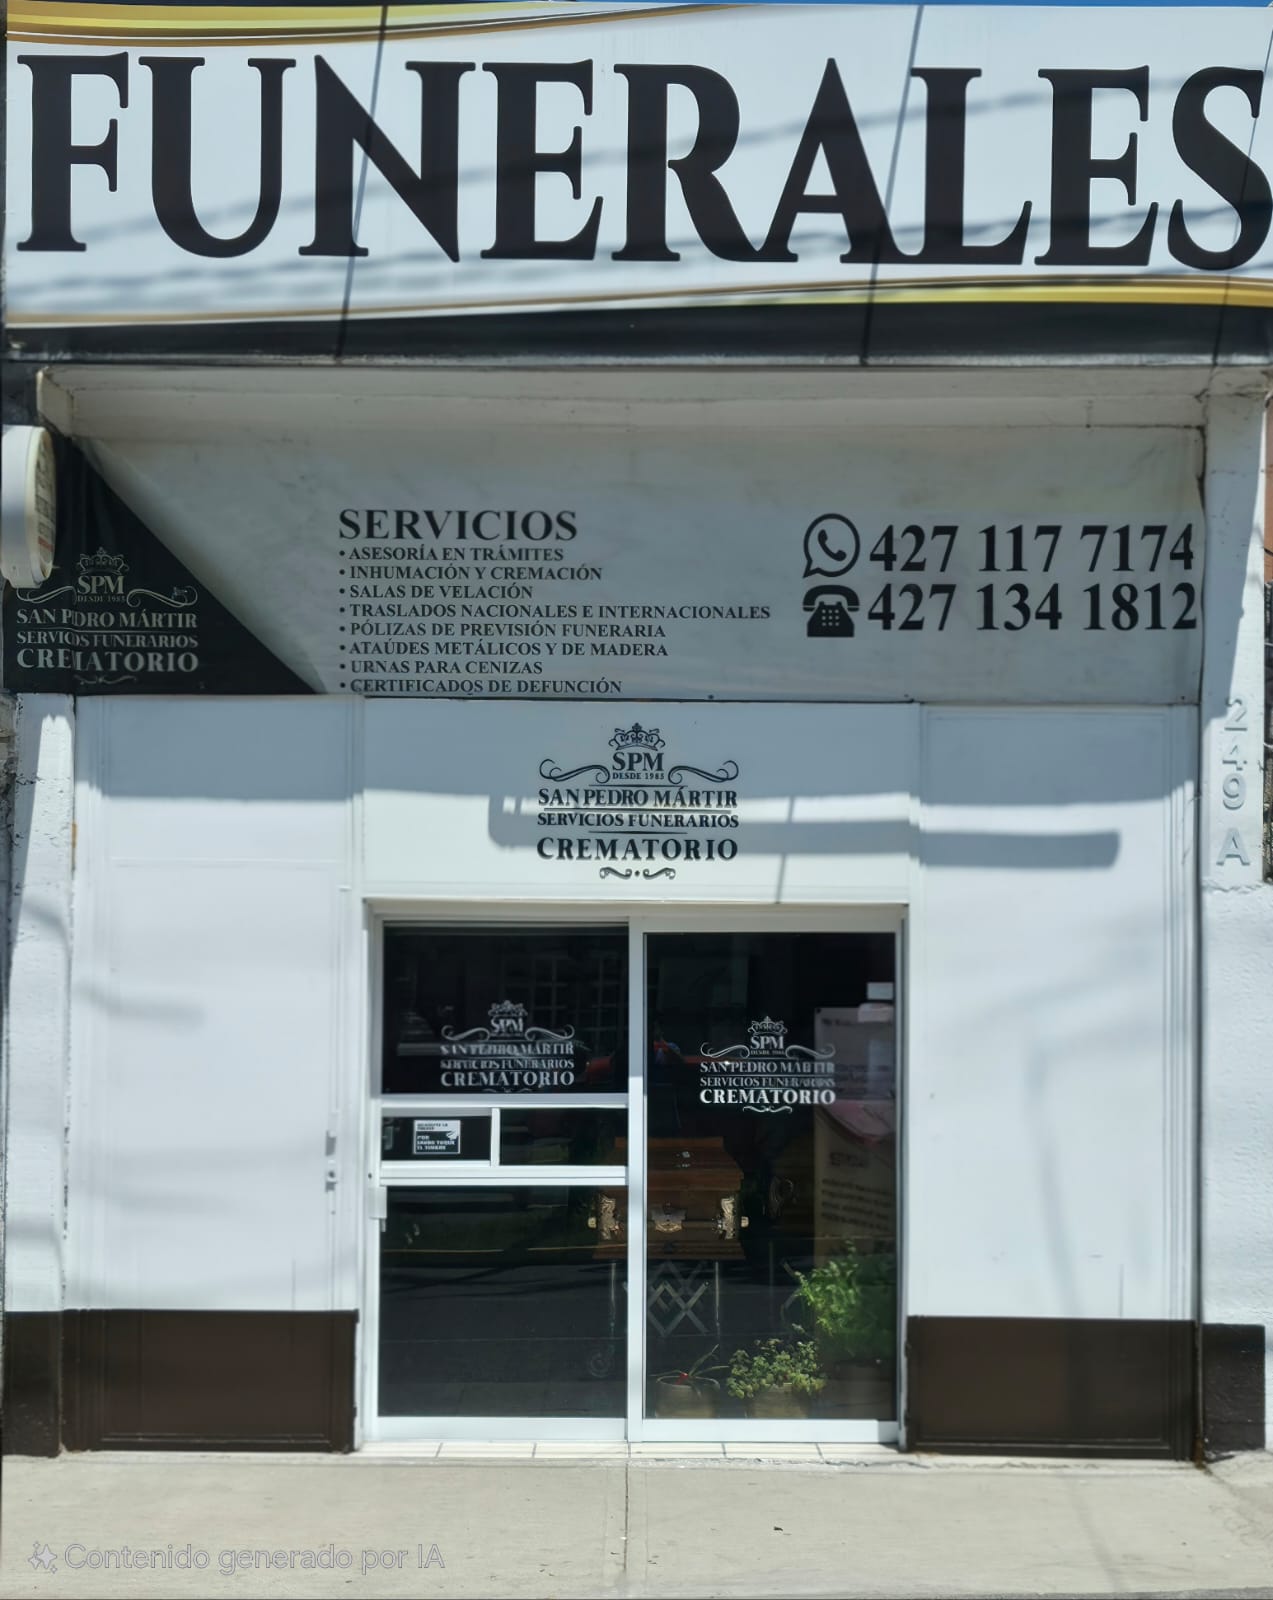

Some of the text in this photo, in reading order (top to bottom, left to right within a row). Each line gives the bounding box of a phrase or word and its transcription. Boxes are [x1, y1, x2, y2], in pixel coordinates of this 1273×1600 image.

[15, 50, 1273, 271] FUNERALES
[338, 509, 577, 541] SERVICIOS
[349, 545, 563, 561] ASESORÍA EN TRÁMITES
[869, 524, 1193, 572] 427 117 7174
[350, 565, 602, 580] INHUMACIÓN Y CREMACIÓN
[77, 576, 124, 594] SPM
[349, 584, 533, 599] SALAS DE VELACIÓN
[350, 604, 770, 619] TRASLADOS NACIONALES E INTERNACIONALES
[868, 582, 1198, 630] 427 134 1812
[17, 609, 56, 623] SAN
[120, 609, 197, 628] MÁRTIR
[350, 620, 666, 638] PÓLIZAS DE PREVISIÓN FUNERARIA
[94, 635, 198, 648] FUNERARIOS
[349, 639, 668, 656] ATAÚDES METÁLICOS Y DE MADERA
[351, 661, 543, 674] URNAS PARA CENIZAS
[351, 677, 622, 693] CERTIFICADOS DE DEFUNCIÓN
[612, 752, 664, 771] SPM
[538, 786, 737, 808] SAN PEDRO MÁRTIR
[538, 813, 739, 828] SERVICIOS FUNERARIOS
[537, 837, 738, 860] CREMATORIO
[750, 1037, 784, 1049] SPM
[700, 1062, 728, 1072] SAN
[731, 1062, 777, 1072] PEDRO
[441, 1071, 575, 1086] CREMATORIO
[700, 1077, 759, 1086] SERVICIOS
[700, 1089, 836, 1104] CREMATORIO
